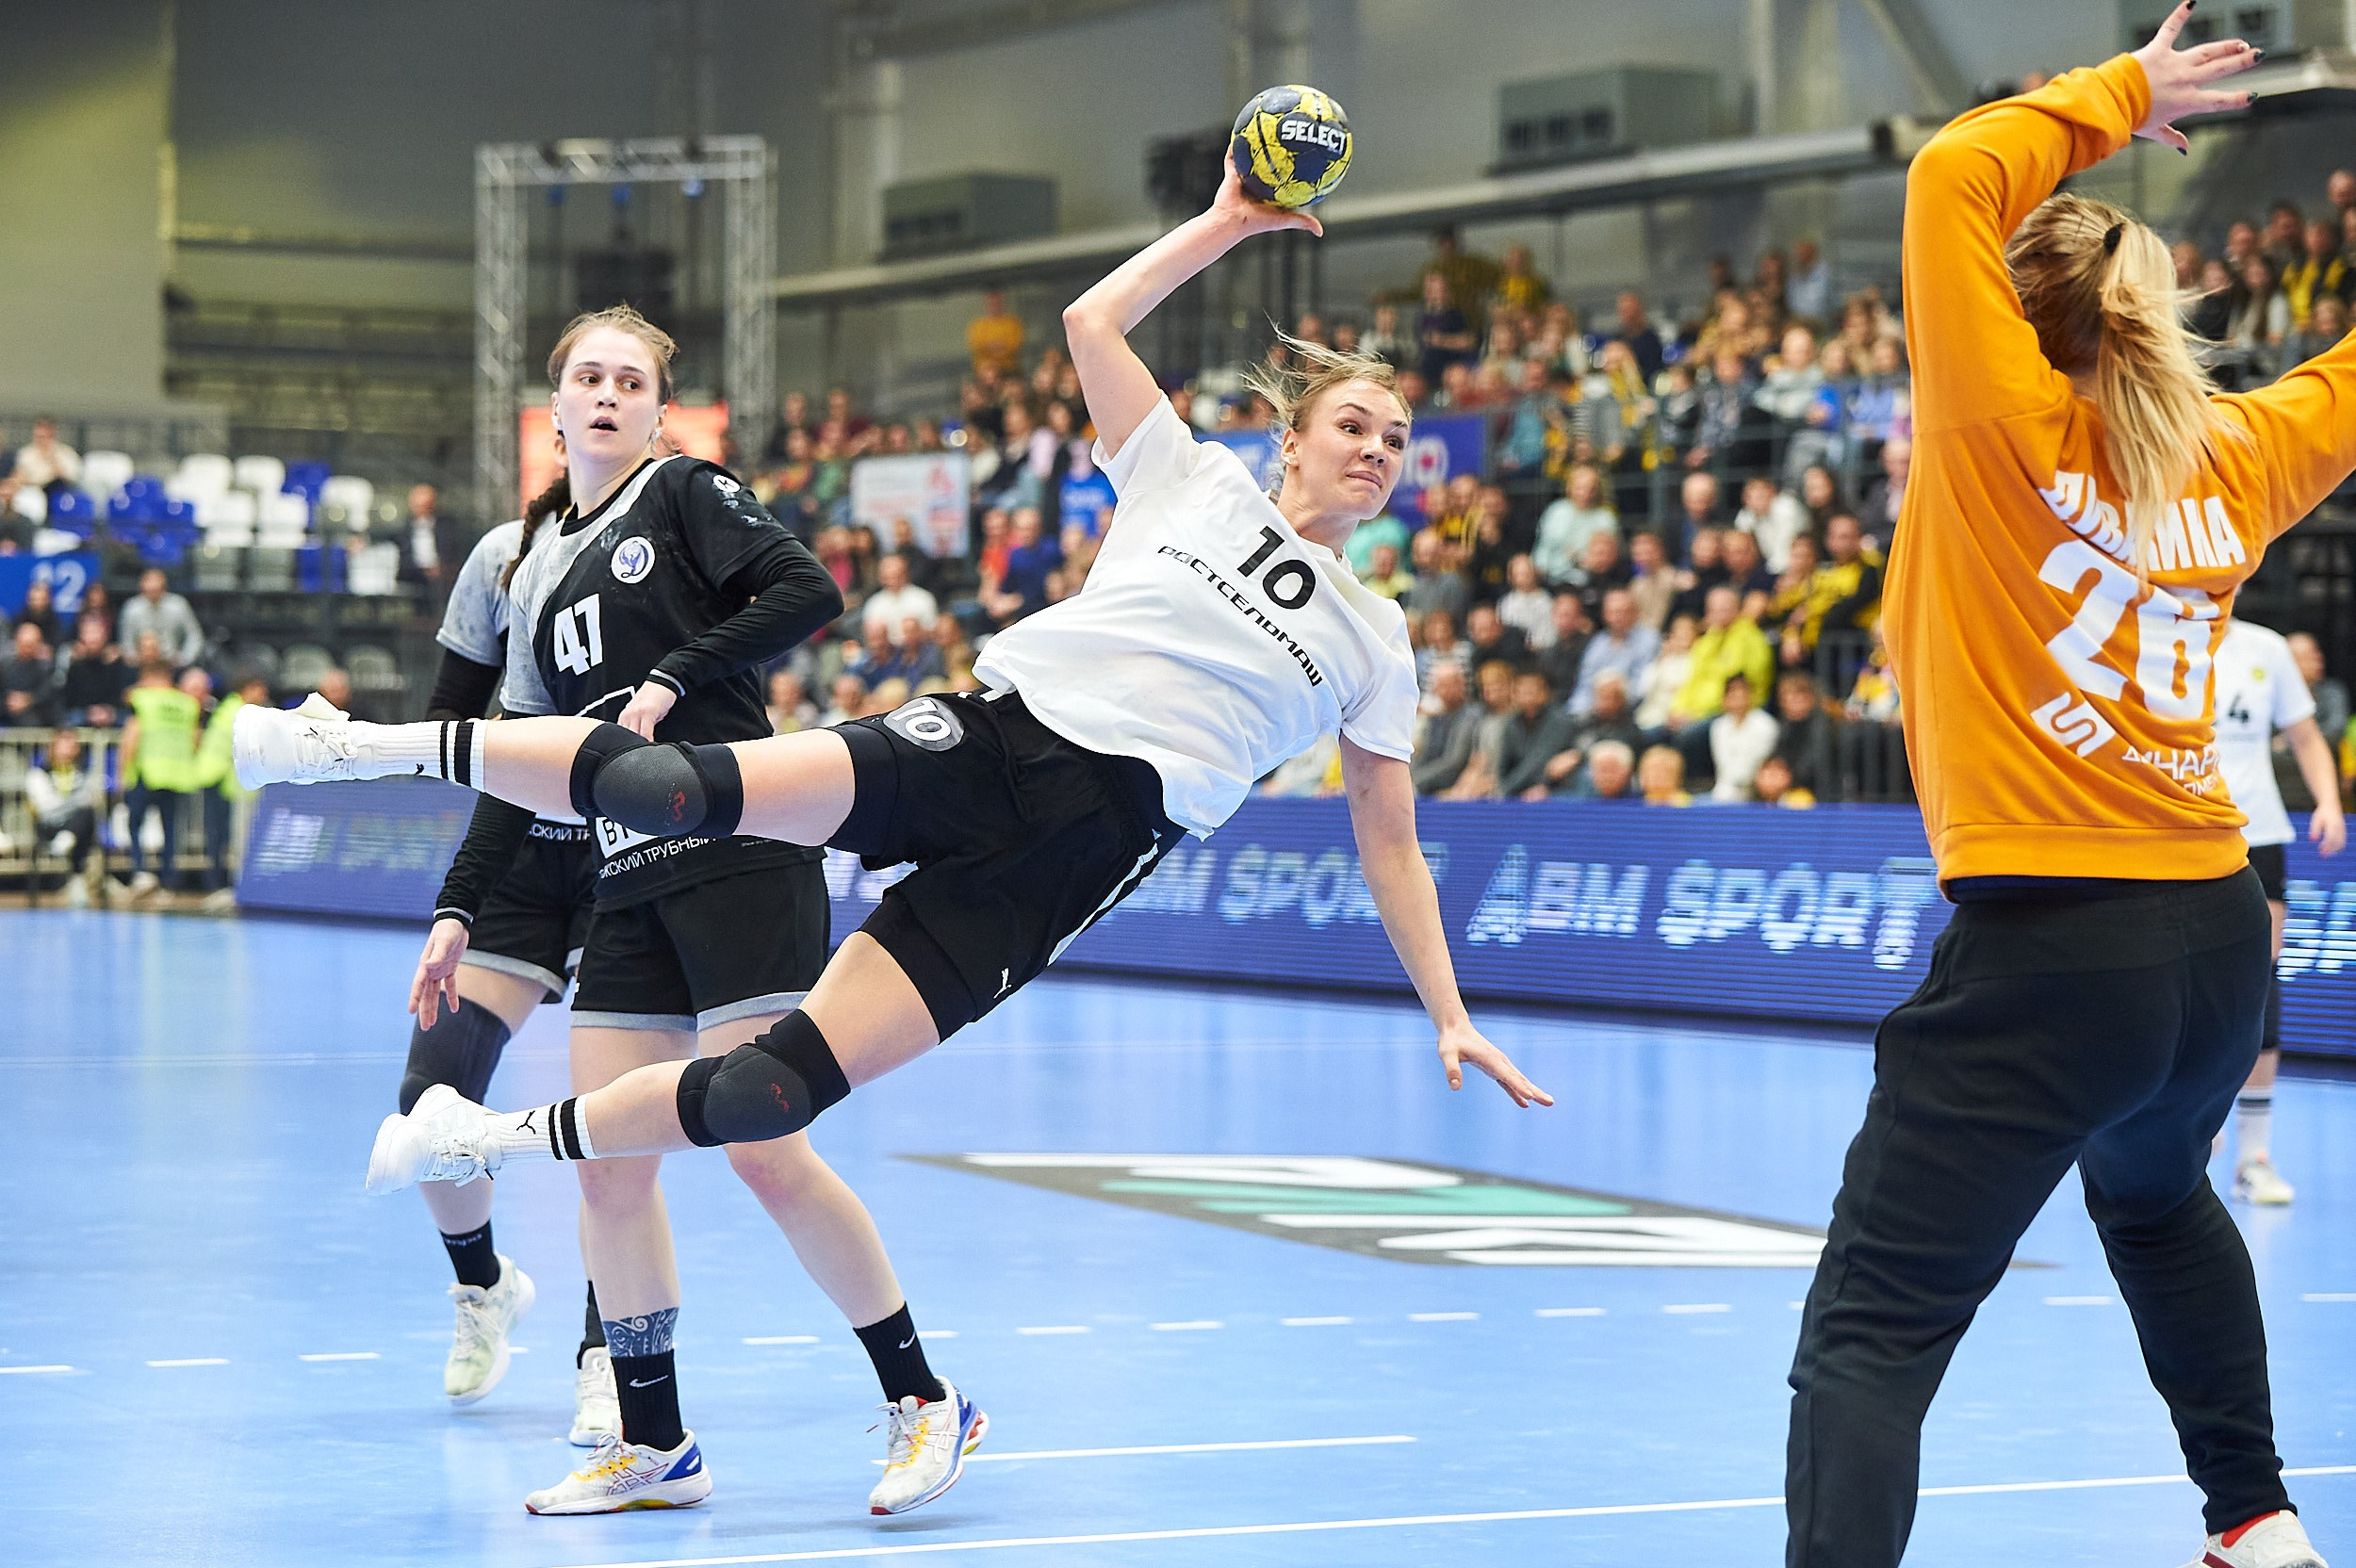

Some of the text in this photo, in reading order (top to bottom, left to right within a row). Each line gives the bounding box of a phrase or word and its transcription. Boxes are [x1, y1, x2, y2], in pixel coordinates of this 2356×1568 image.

[1281, 120, 1347, 155] SELECT
[1236, 525, 1317, 610] 10
[553, 593, 604, 676] 47
[1157, 546, 1323, 687] РОСТСЕЛЬМАШ
[892, 698, 952, 742] 10
[529, 822, 572, 841] СКИЙ
[644, 835, 717, 863] ТРУБНЫ
[1656, 858, 1939, 970] SPORT
